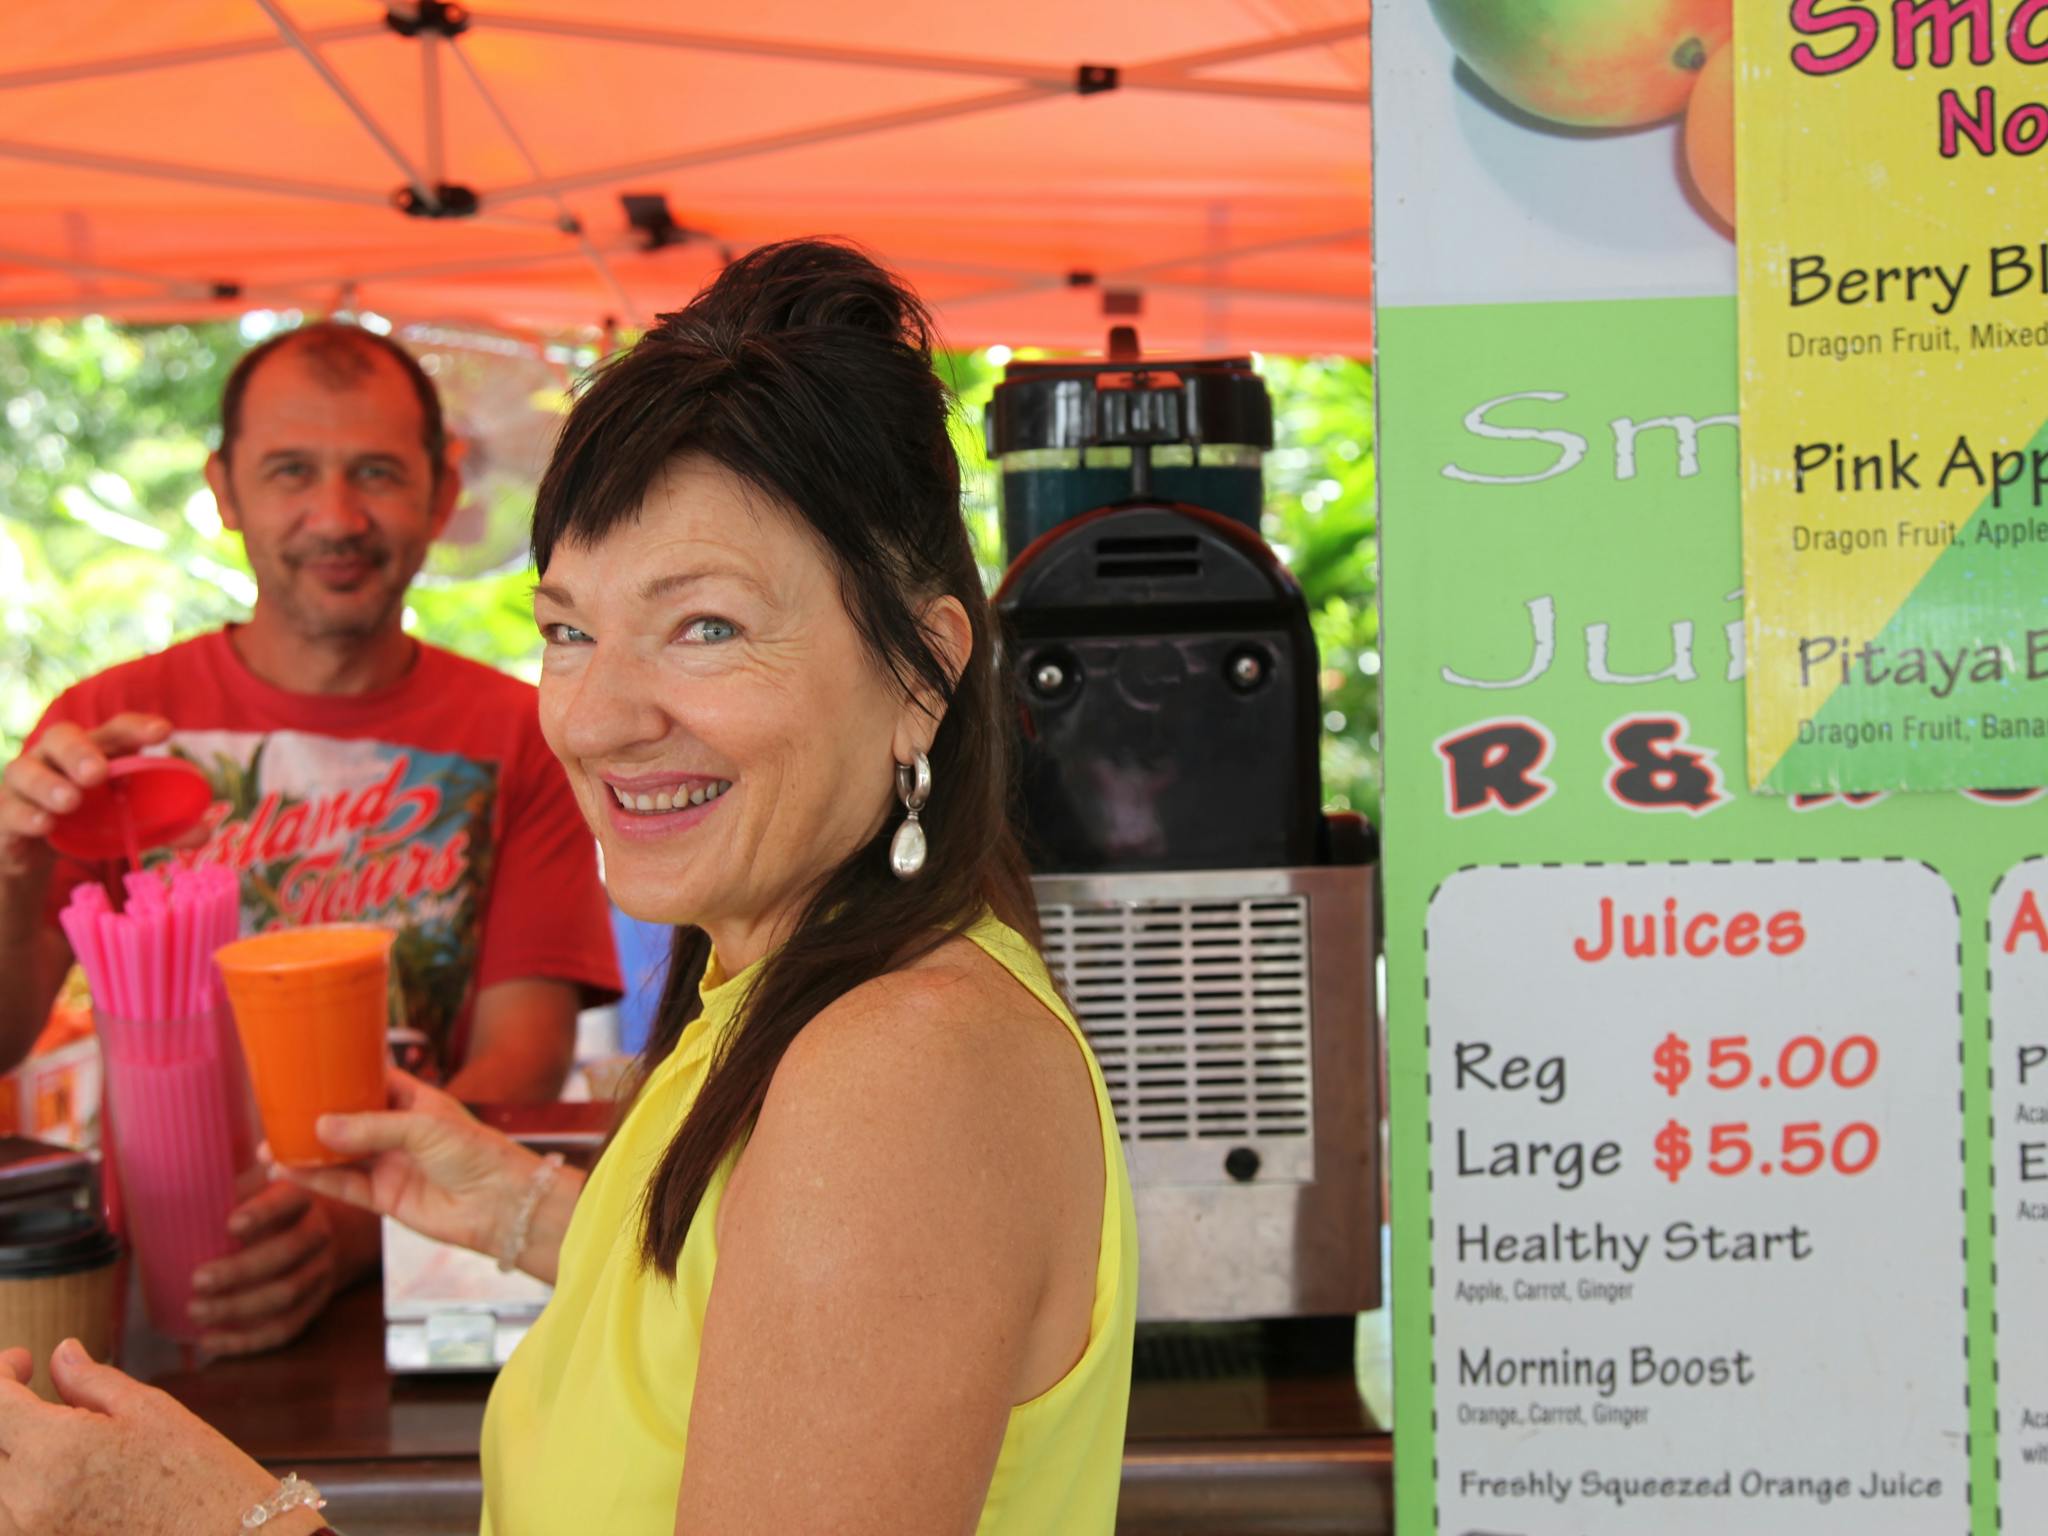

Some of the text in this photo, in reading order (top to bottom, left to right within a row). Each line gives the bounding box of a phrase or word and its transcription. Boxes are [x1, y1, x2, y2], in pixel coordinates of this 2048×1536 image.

[1938, 85, 2048, 158] No
[1788, 243, 2048, 314] Berry Bl
[1788, 322, 2048, 361] Dragon Fruit, Mixed
[1440, 390, 1740, 485] Sm
[1794, 438, 1920, 493] Pink
[1793, 517, 2048, 555] Dragon Fruit, Apple
[1798, 634, 2003, 698] Pitaya
[1798, 712, 2048, 749] Dragon Fruit, Bana
[1434, 712, 1735, 817] R &
[1573, 896, 1807, 962] Juices
[2004, 889, 2048, 954] A
[1454, 1032, 1879, 1103] Reg $5.00
[2017, 1045, 2048, 1086] P
[1456, 1119, 1880, 1190] Large $5.50
[2019, 1142, 2048, 1182] E
[1457, 1221, 1814, 1272] Healthy Start
[1455, 1279, 1634, 1304] Apple, Carrot, Ginger
[1458, 1345, 1755, 1397] Morning Boost
[1458, 1401, 1649, 1428] Orange, Carrot, Ginger
[1460, 1469, 1943, 1506] Freshly Squeezed Orange Juice
